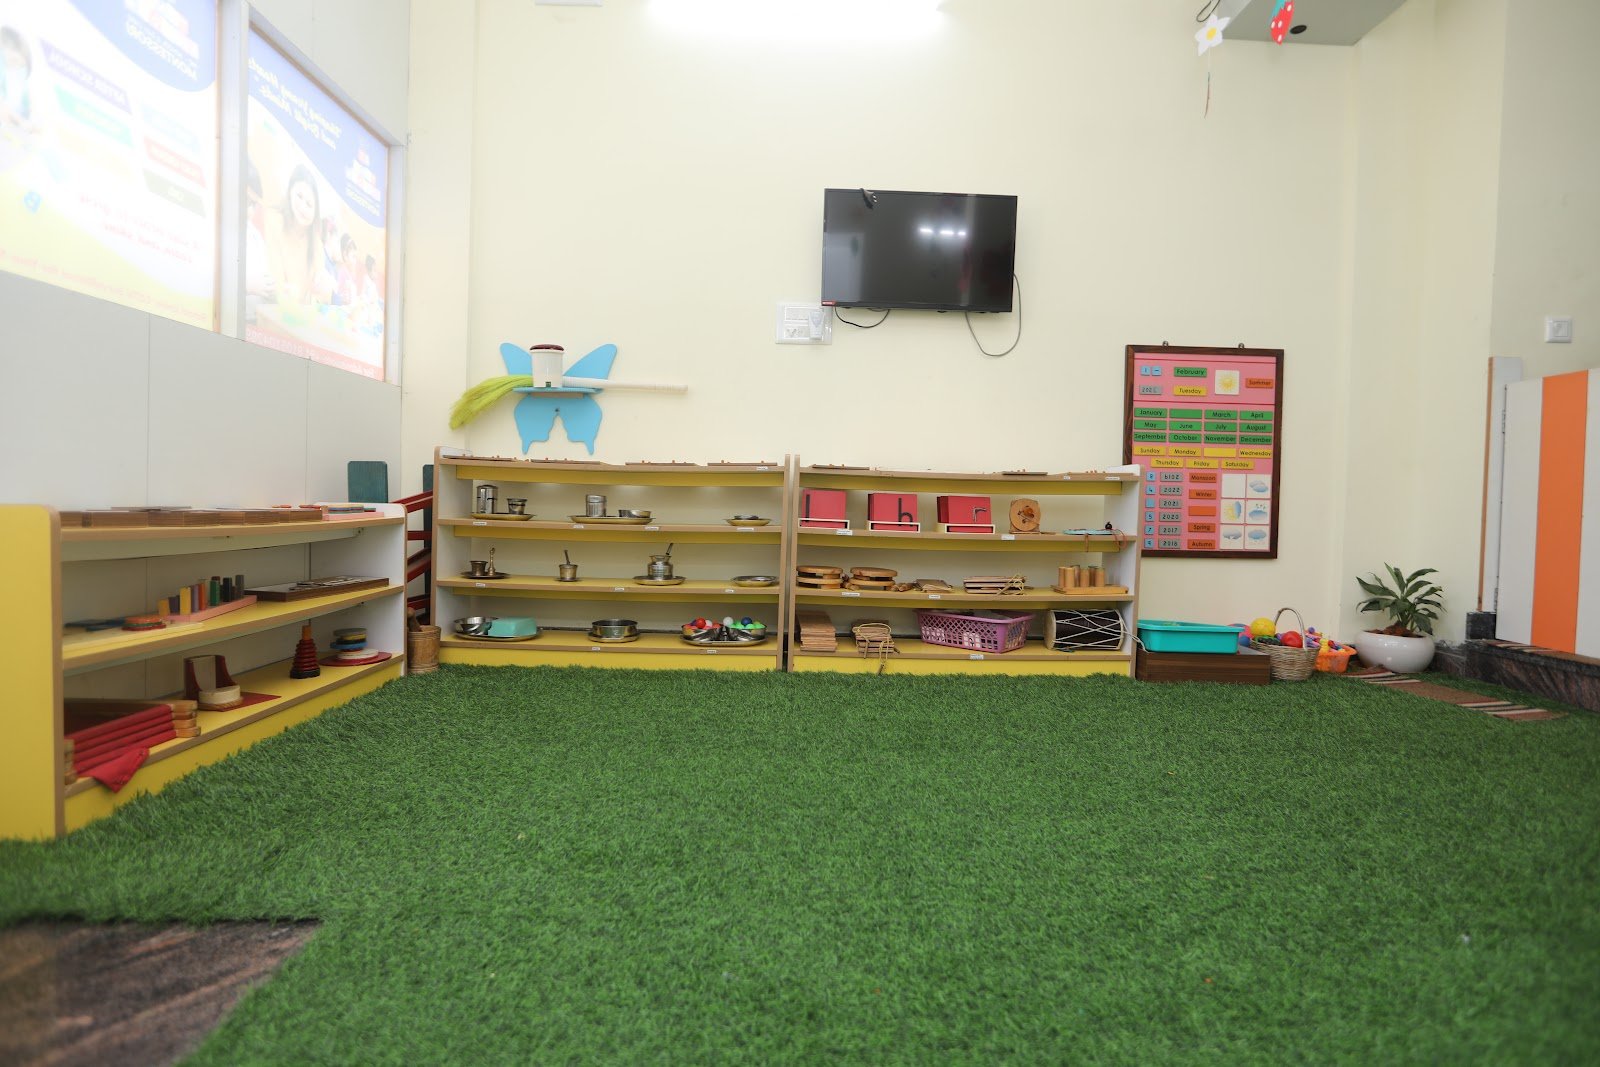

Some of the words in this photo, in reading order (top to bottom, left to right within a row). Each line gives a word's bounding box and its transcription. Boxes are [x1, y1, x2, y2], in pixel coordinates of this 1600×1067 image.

[1176, 368, 1205, 376] February
[1248, 379, 1272, 387] Summer
[1178, 387, 1202, 395] Tuesday
[1139, 409, 1163, 417] January
[1134, 433, 1167, 441] September
[1174, 448, 1197, 456] Monday
[1240, 449, 1272, 457] Wednesday
[1155, 459, 1179, 467] Thursday
[1193, 460, 1210, 468] Friday
